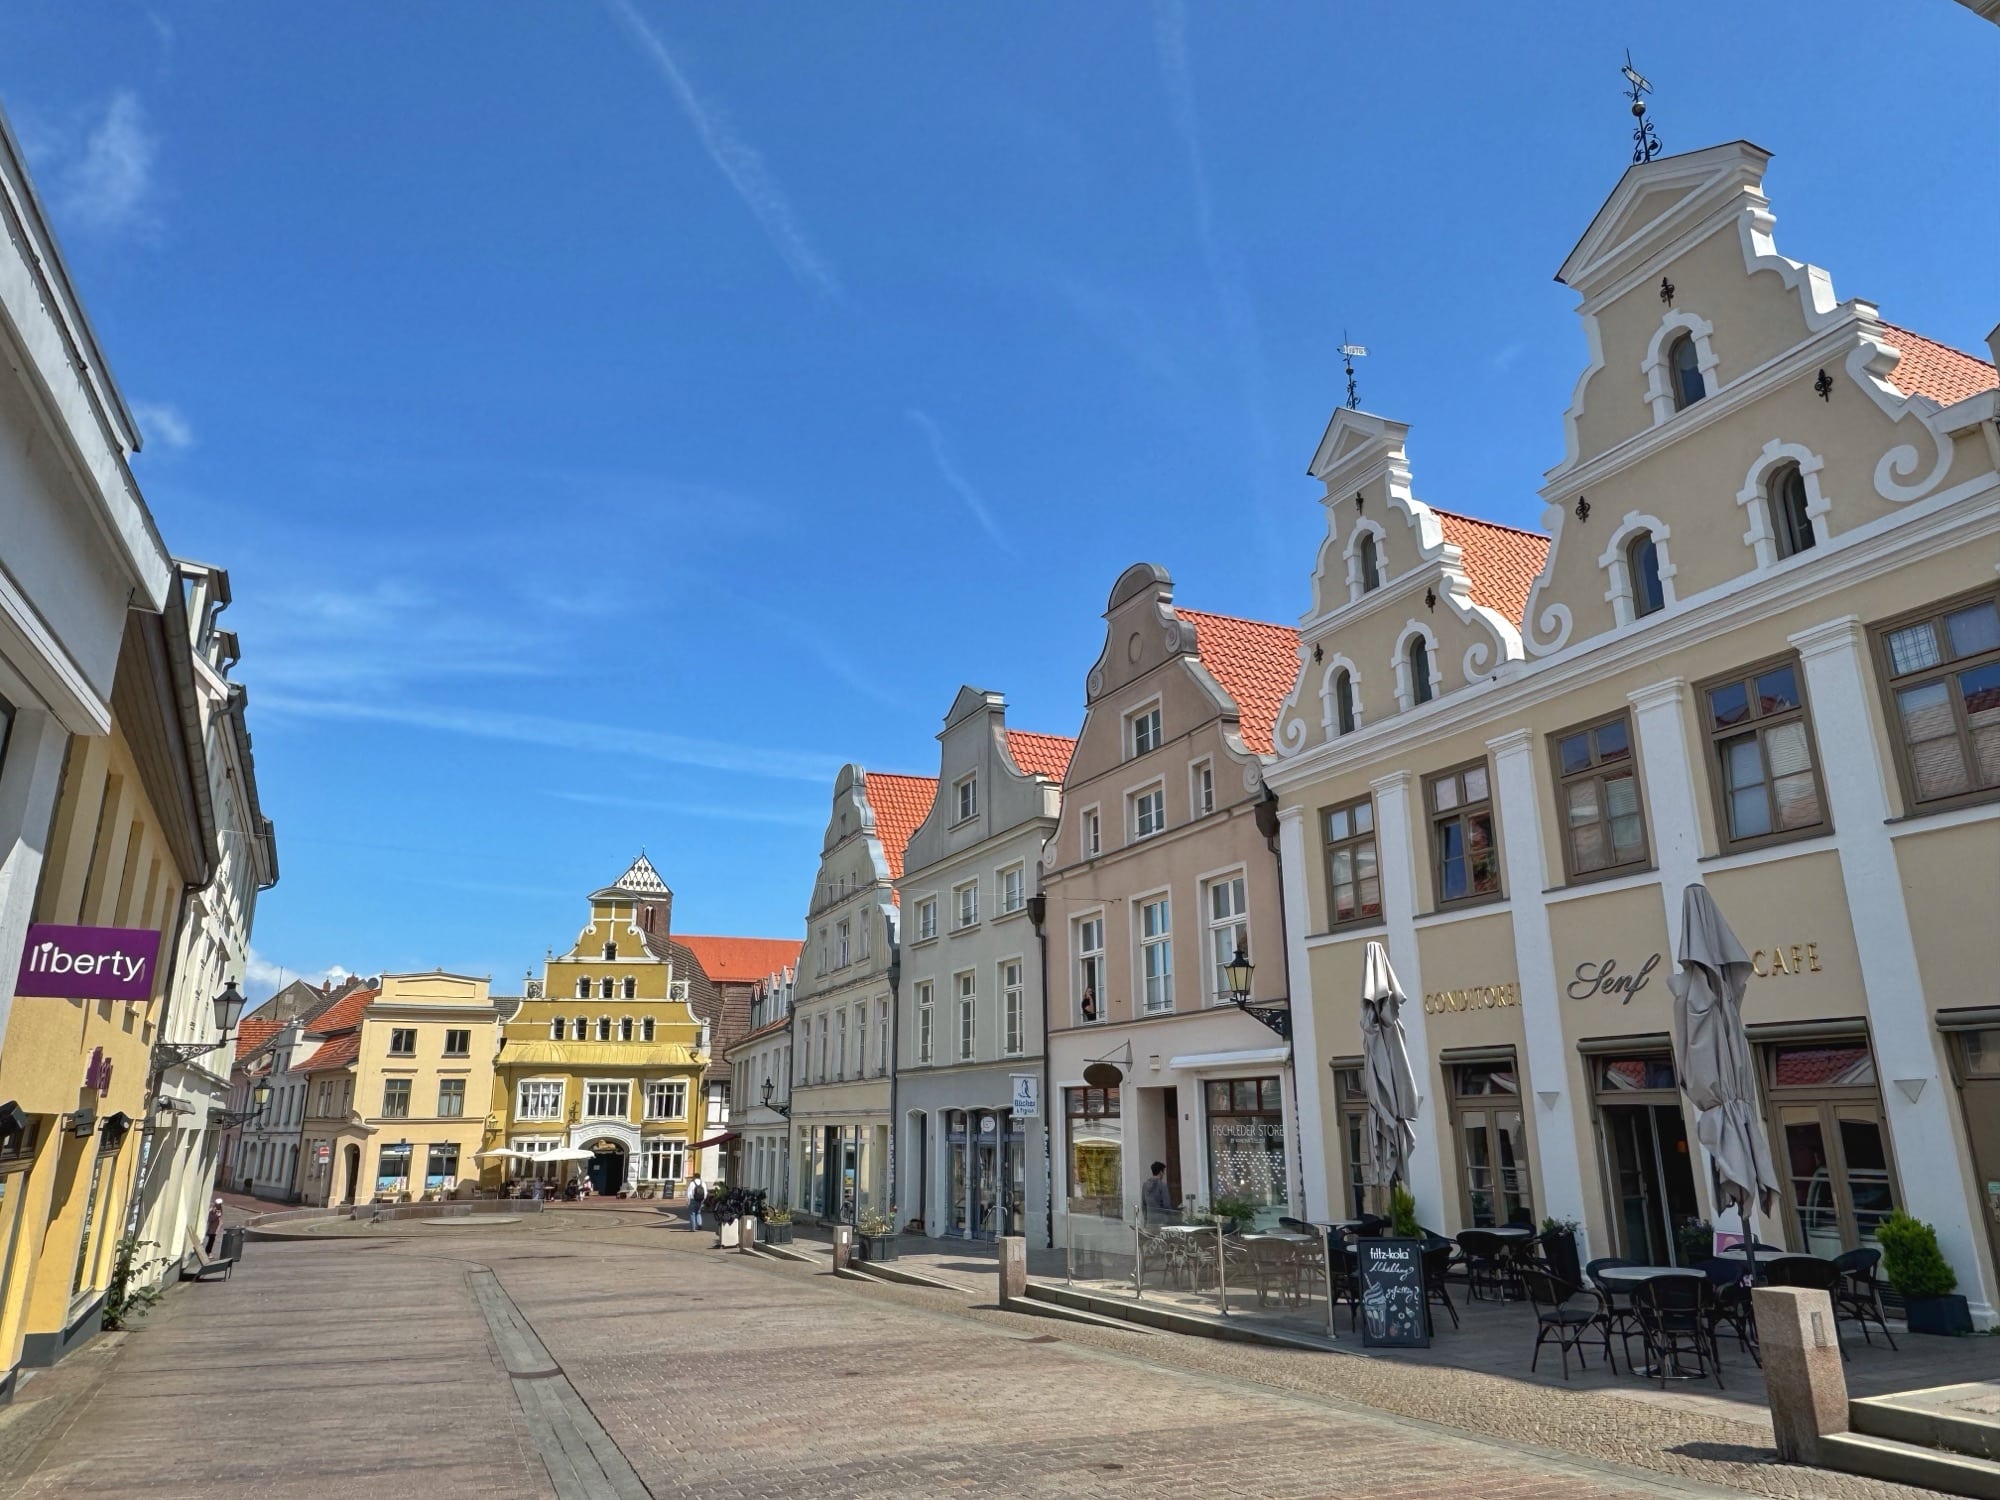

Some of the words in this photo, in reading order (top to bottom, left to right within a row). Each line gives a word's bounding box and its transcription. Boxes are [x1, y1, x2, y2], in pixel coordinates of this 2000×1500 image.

[29, 942, 145, 982] liberty
[1567, 953, 1662, 1005] Senf
[1370, 1247, 1409, 1260] fritz-kola
